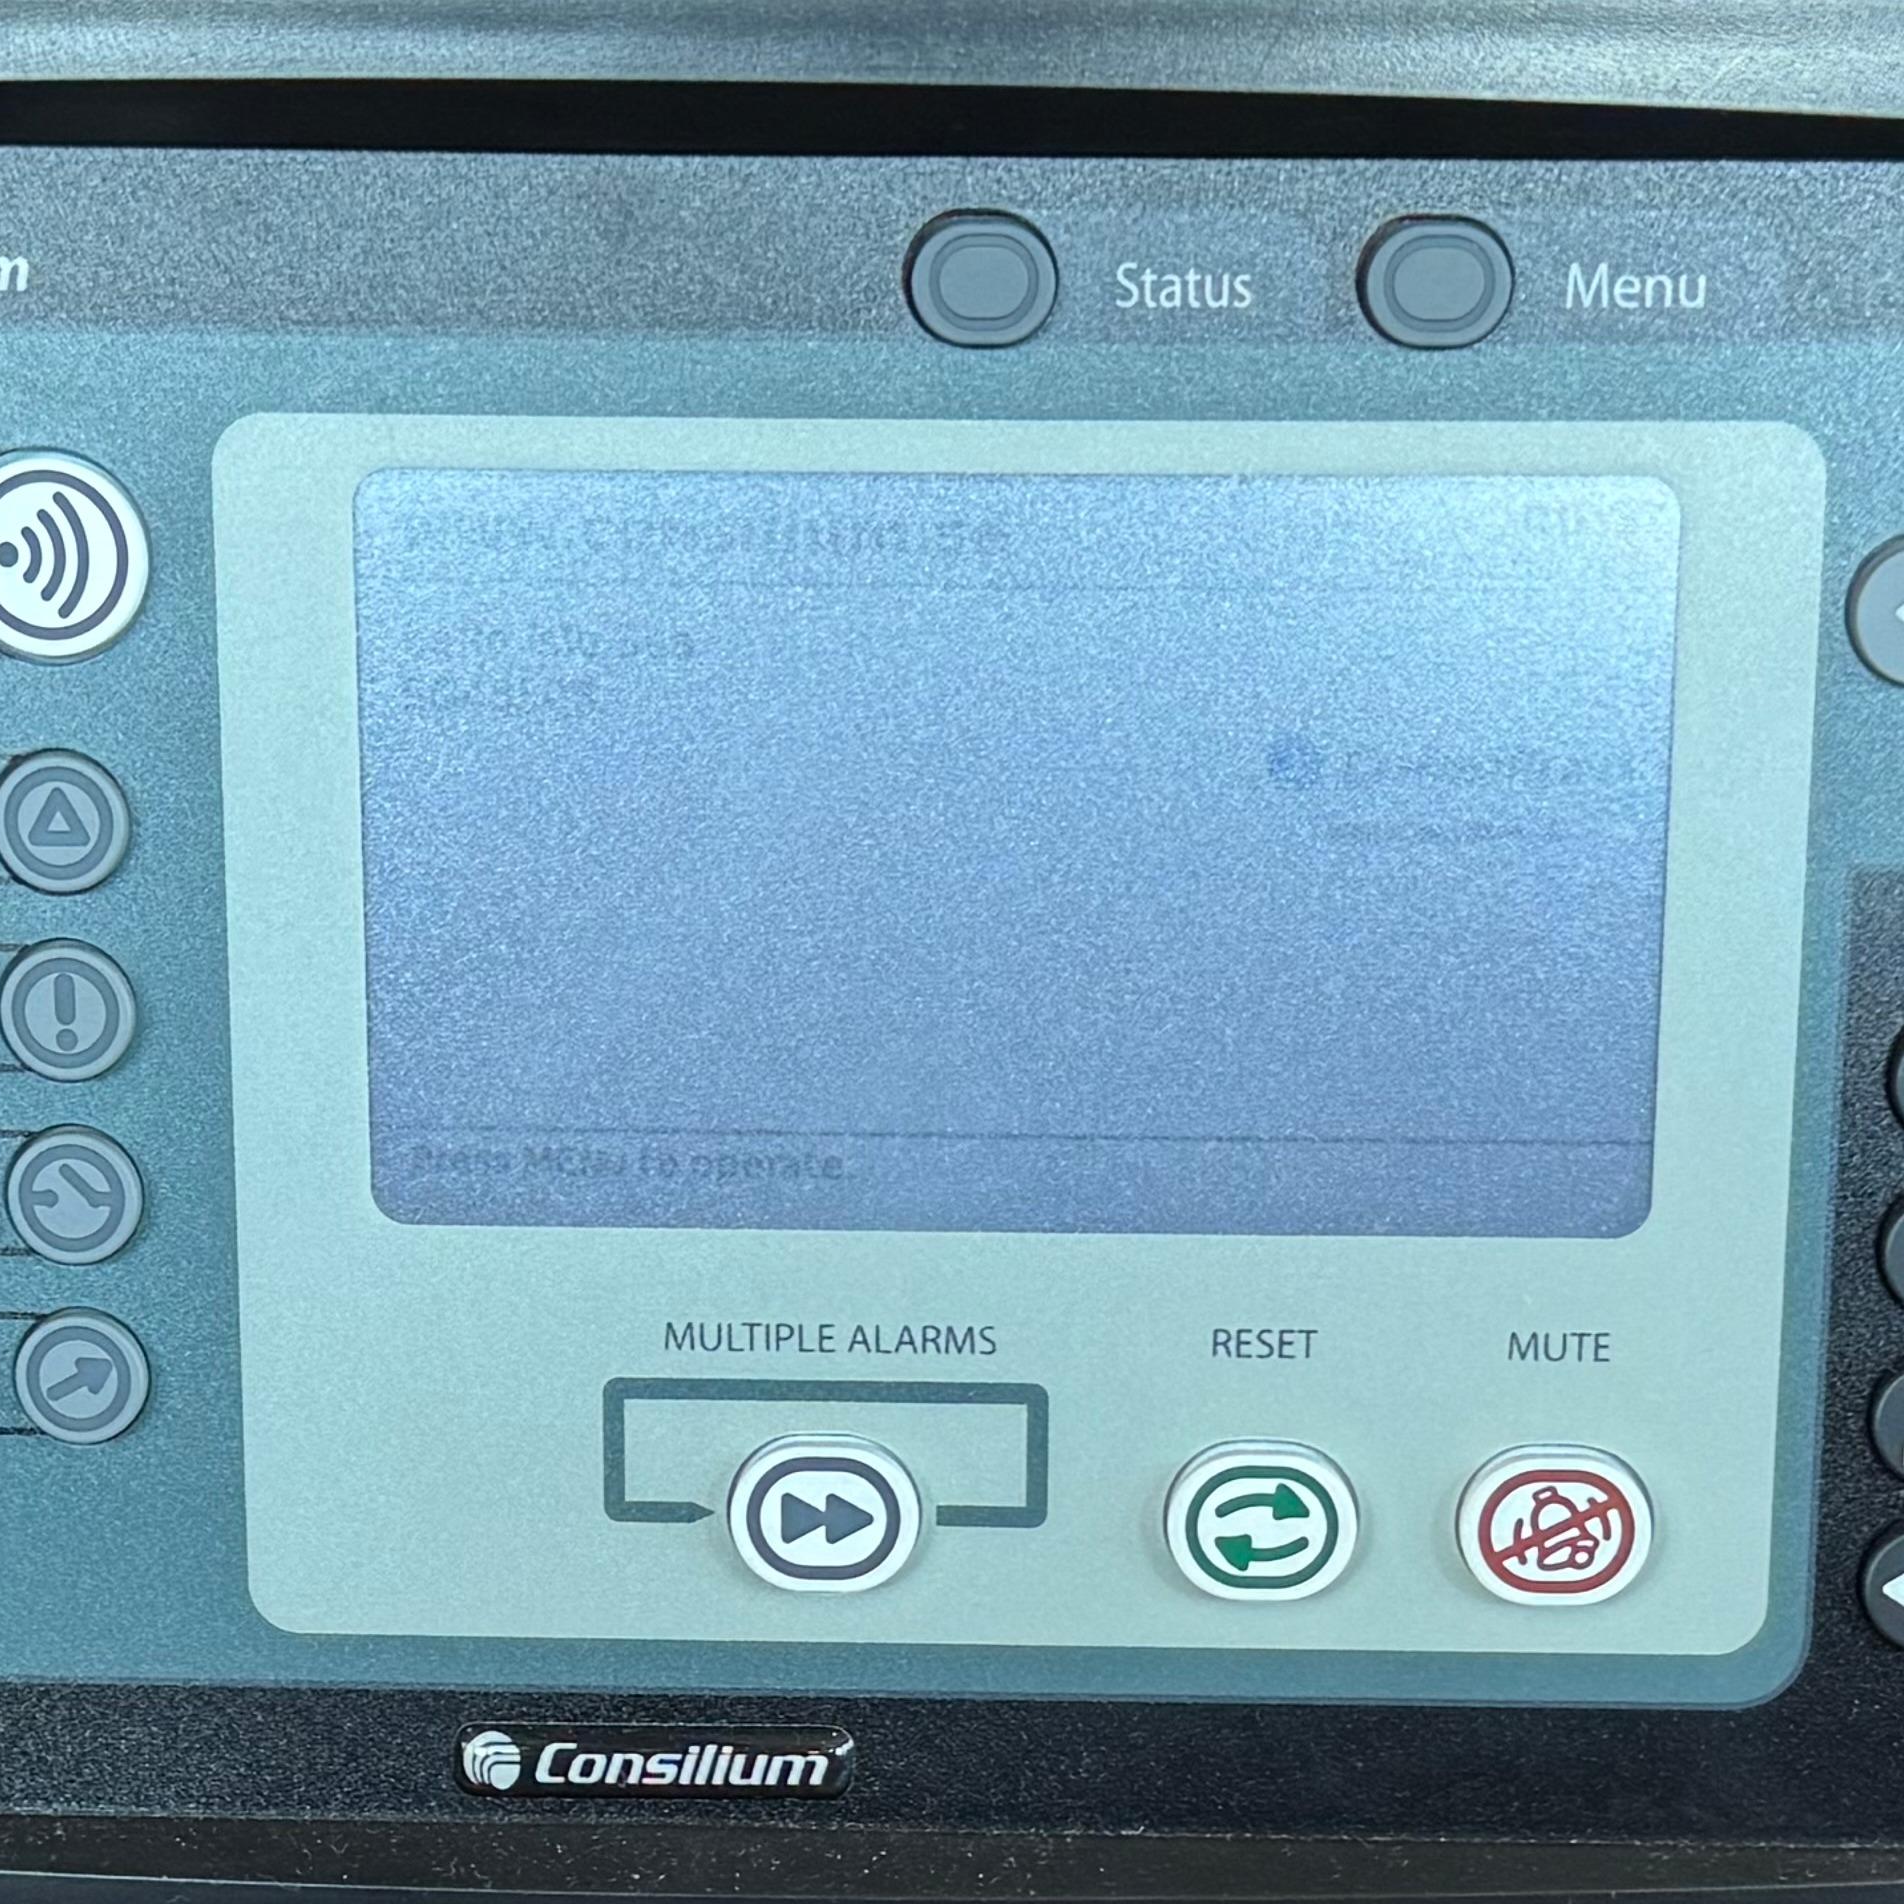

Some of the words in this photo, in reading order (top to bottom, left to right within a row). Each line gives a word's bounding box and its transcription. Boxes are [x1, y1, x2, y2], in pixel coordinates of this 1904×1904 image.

[1115, 261, 1253, 309] Status
[1566, 261, 1707, 309] Menu
[663, 1321, 836, 1355] MULTIPLE
[847, 1325, 998, 1357] ALARMS
[1210, 1329, 1318, 1360] RESET
[1507, 1332, 1612, 1363] MUTE
[534, 1742, 830, 1787] Consilium
